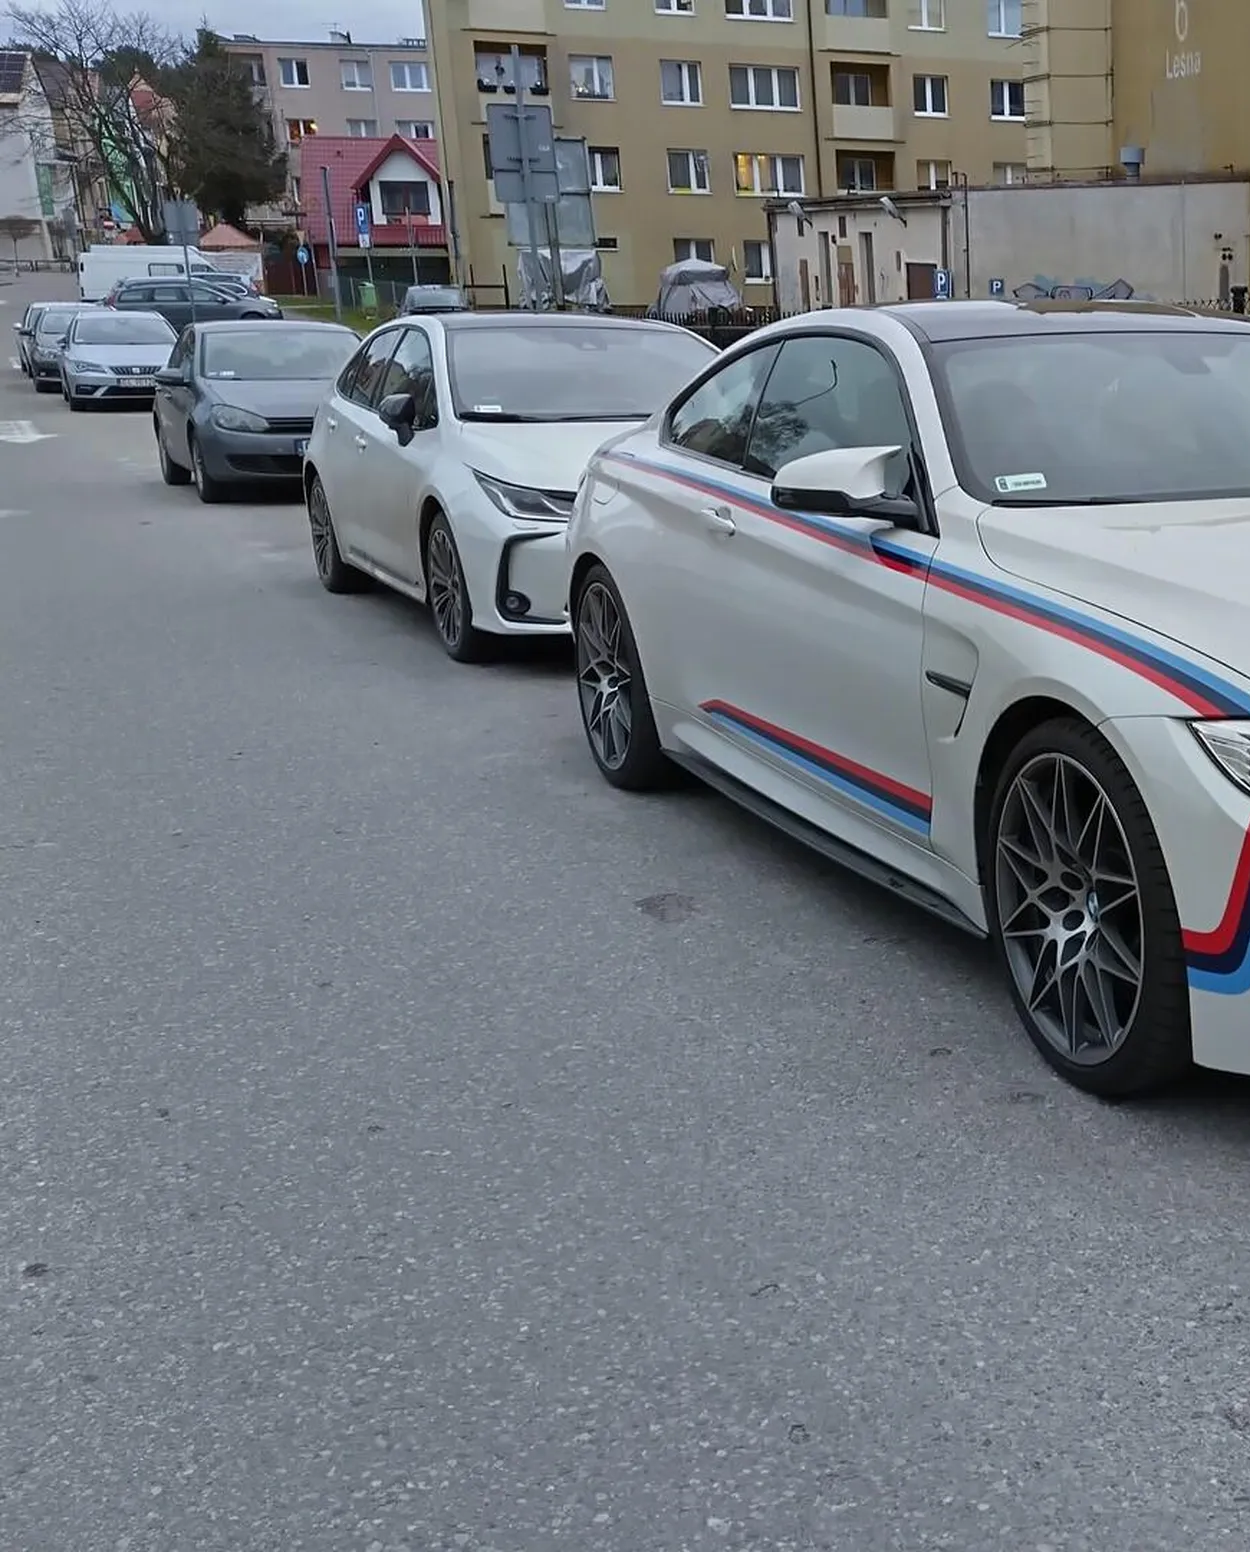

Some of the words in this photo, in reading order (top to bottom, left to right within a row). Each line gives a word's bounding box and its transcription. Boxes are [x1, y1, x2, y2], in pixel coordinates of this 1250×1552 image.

[357, 207, 365, 226] P
[937, 272, 946, 290] P
[992, 280, 1001, 293] P
